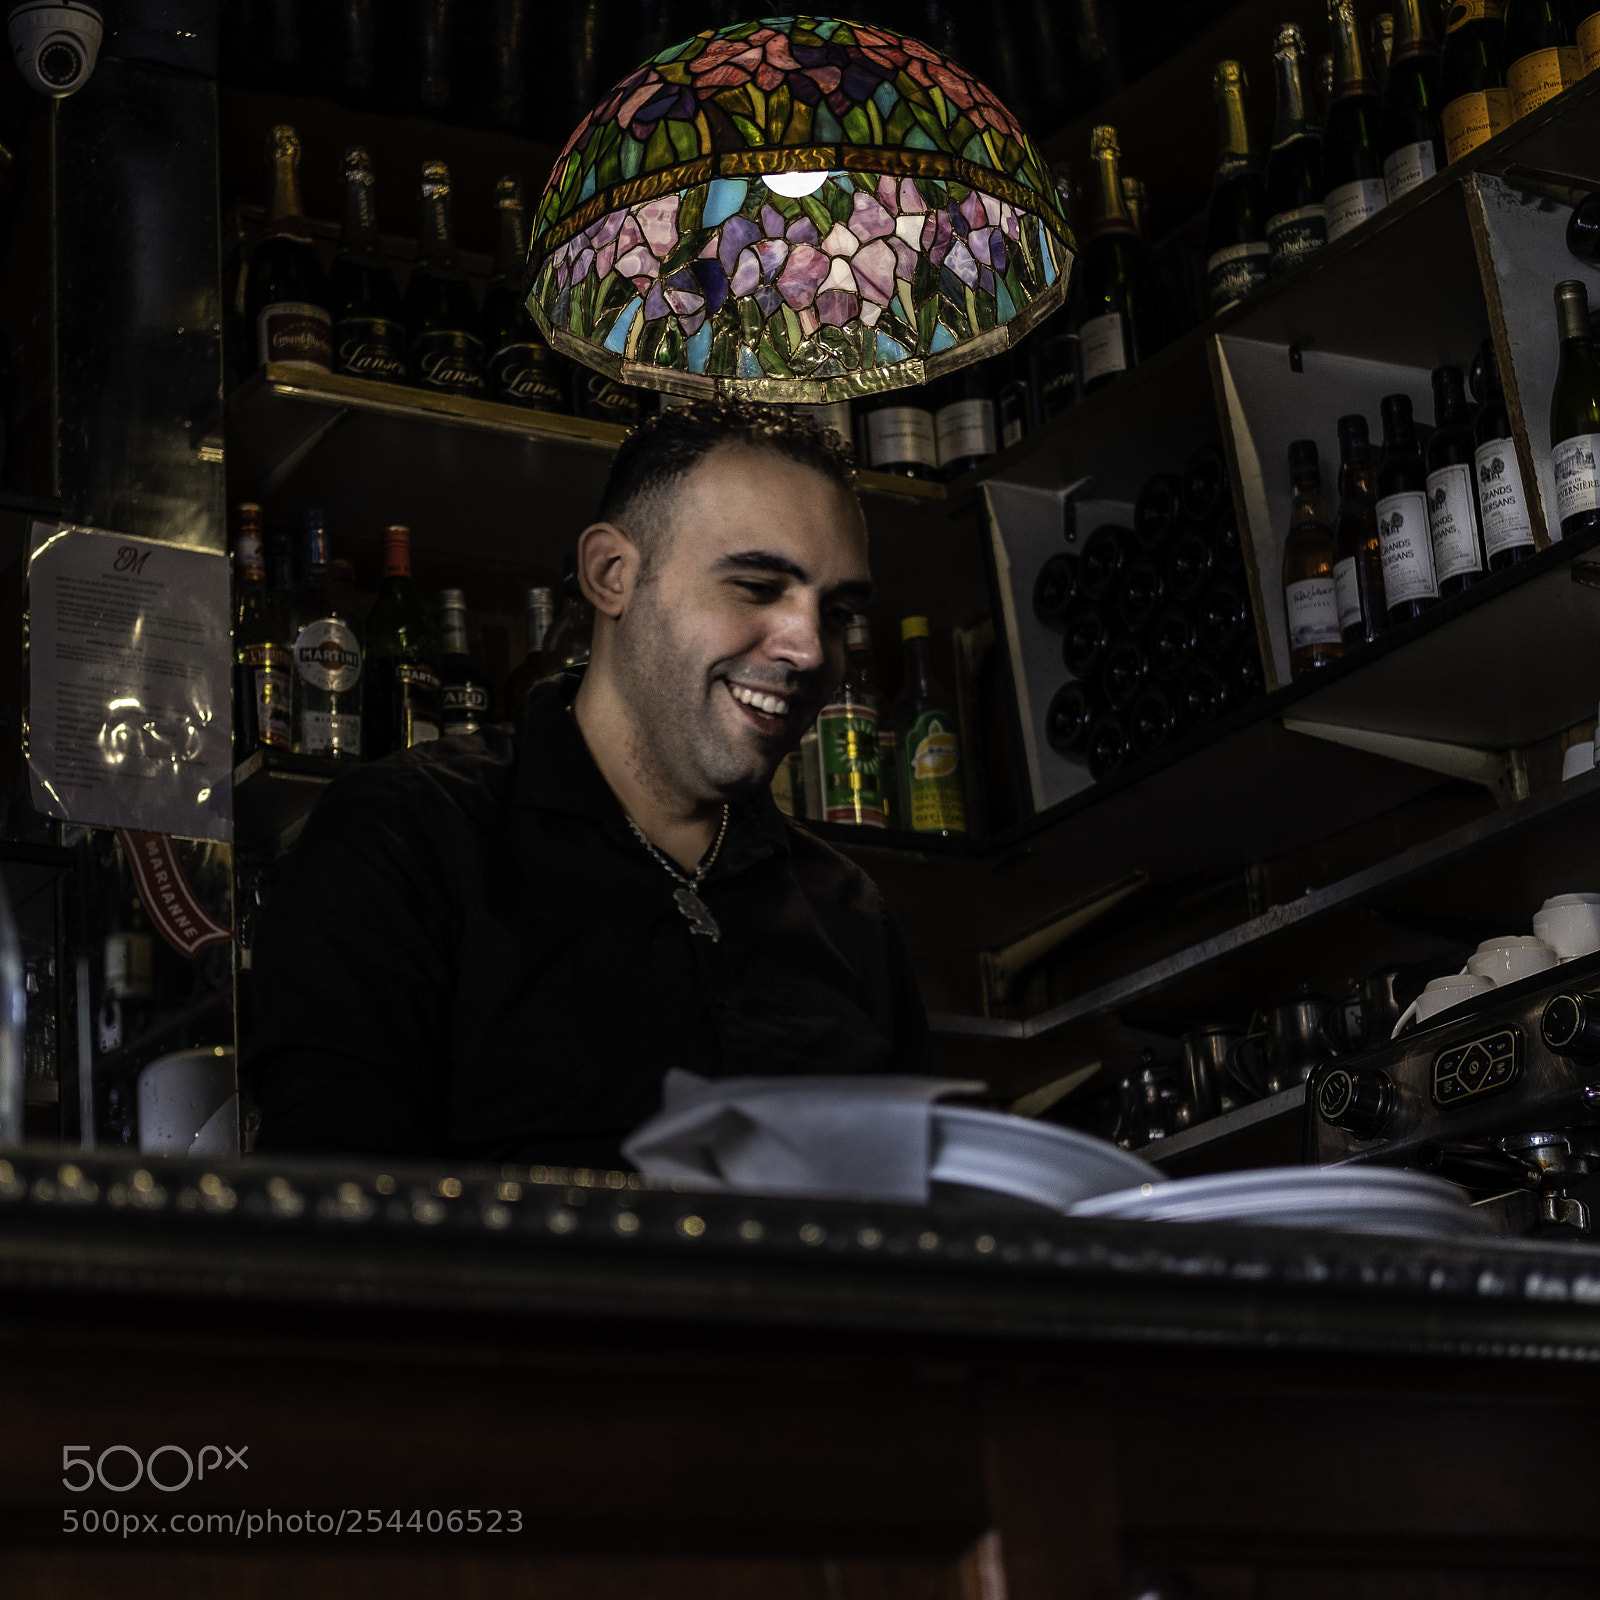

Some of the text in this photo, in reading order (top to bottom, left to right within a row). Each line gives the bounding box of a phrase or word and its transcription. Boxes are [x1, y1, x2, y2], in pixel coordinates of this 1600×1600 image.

[587, 374, 640, 410] Lans
[300, 648, 359, 668] MARTINI
[444, 691, 484, 705] ARD
[145, 840, 199, 939] MARIANNE
